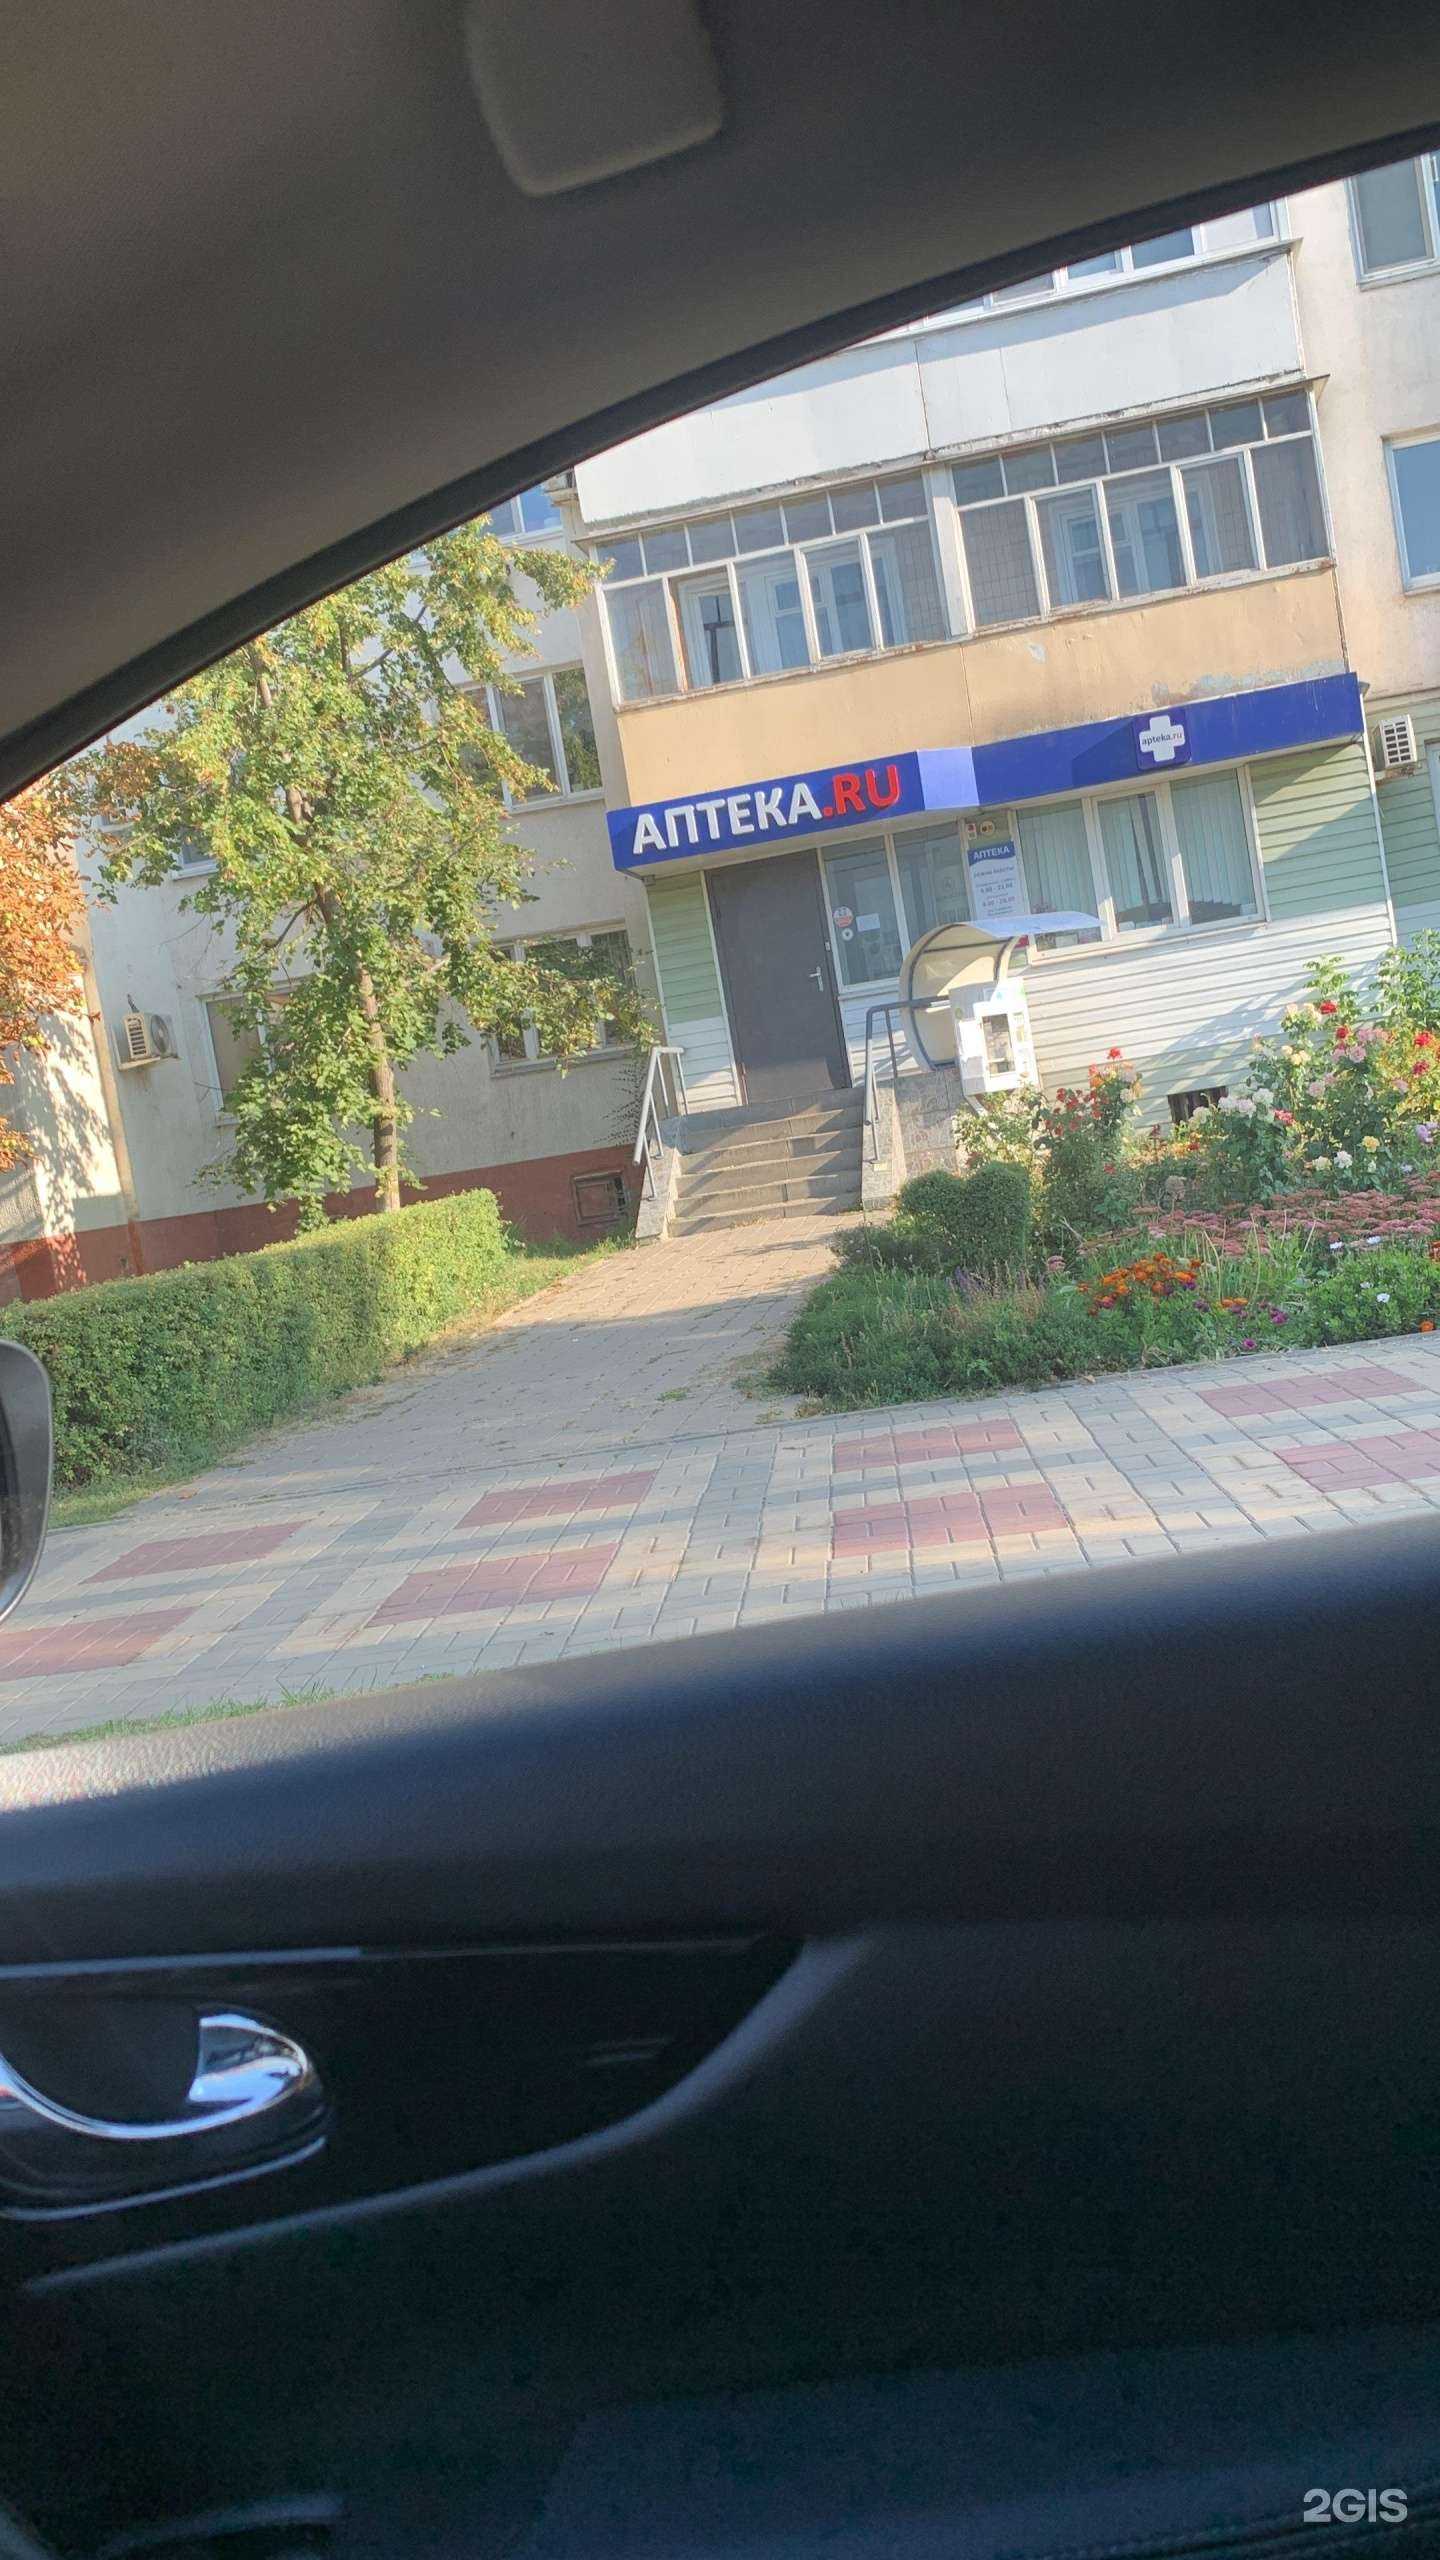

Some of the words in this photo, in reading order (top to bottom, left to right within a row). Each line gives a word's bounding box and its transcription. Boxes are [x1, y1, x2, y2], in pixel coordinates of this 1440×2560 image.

[1142, 733, 1183, 746] apteka.ru
[633, 764, 901, 855] АПТЕКА.RU
[973, 846, 1010, 859] АПТЕКА
